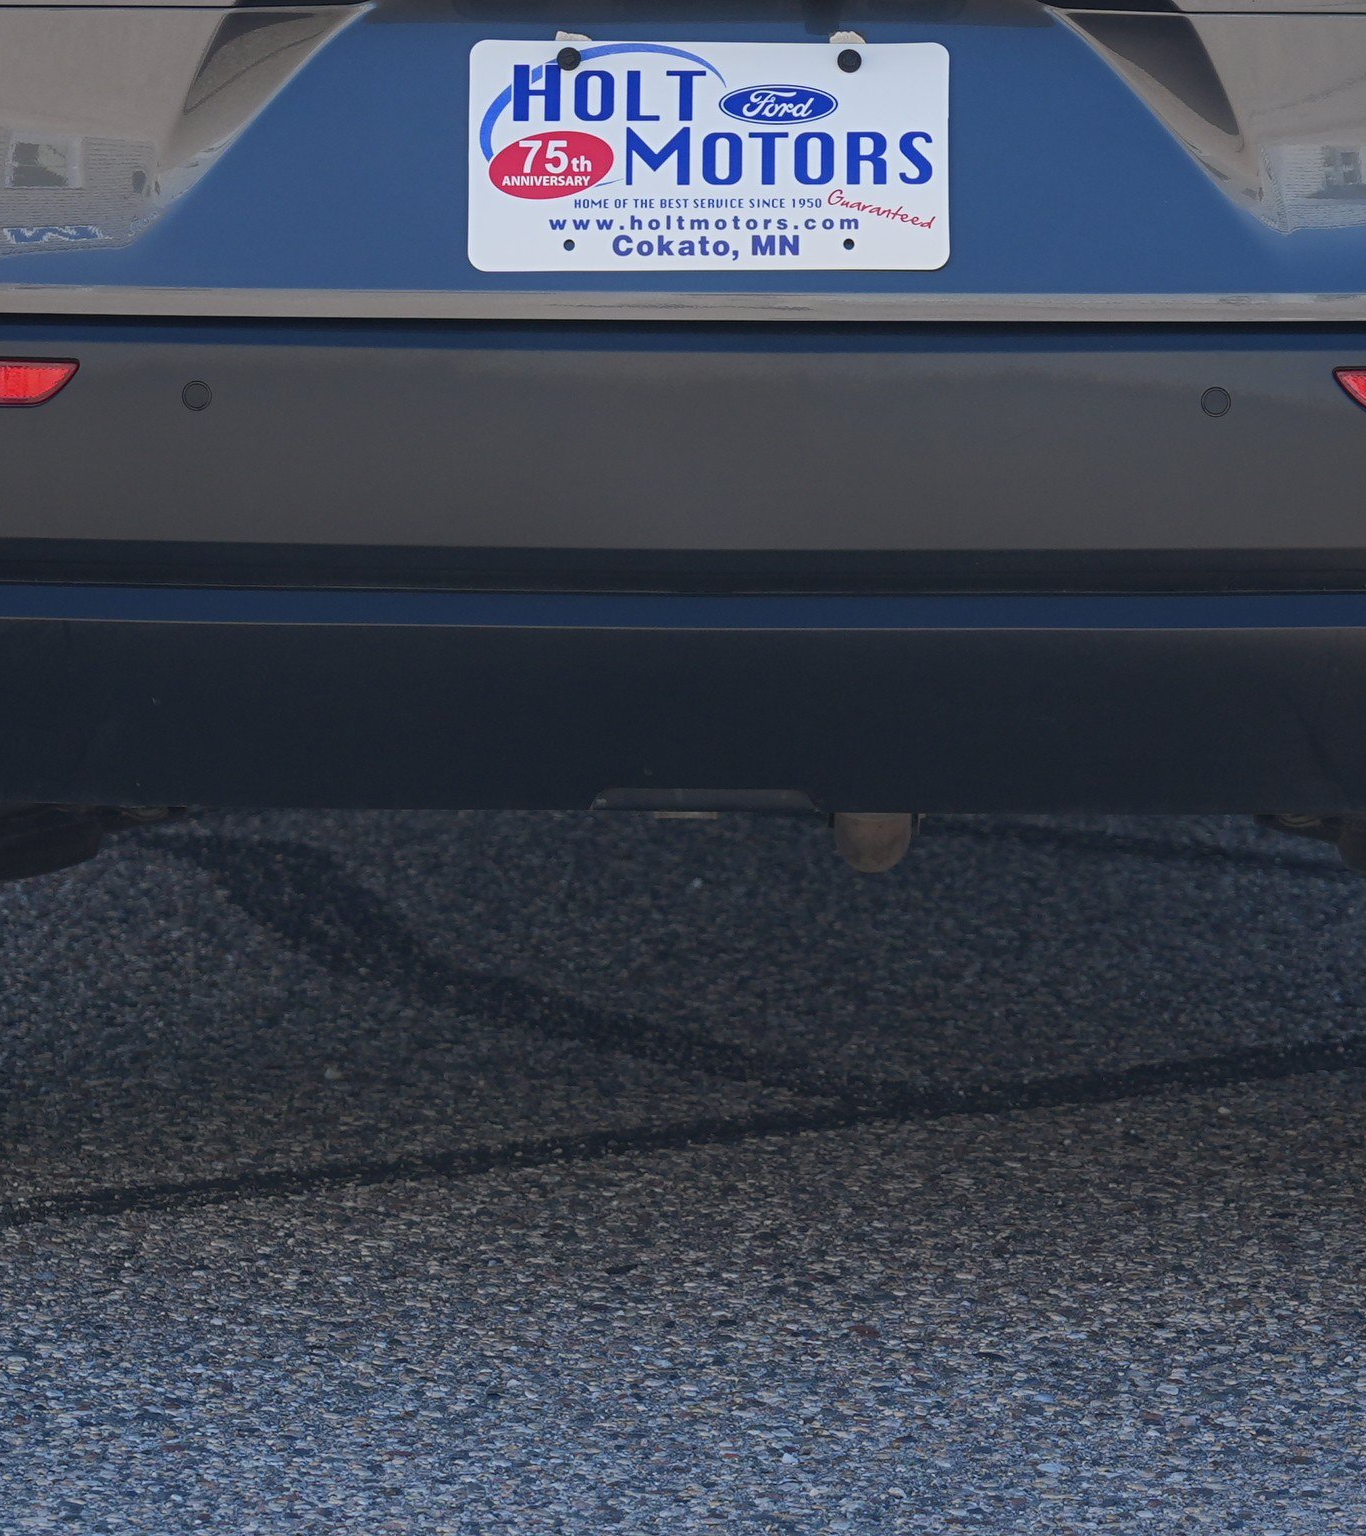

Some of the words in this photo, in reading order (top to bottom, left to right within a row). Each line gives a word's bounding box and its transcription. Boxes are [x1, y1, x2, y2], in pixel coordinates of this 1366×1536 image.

[513, 64, 707, 122] HOLT
[742, 90, 815, 118] Ford
[518, 140, 592, 174] 75th
[625, 126, 933, 186] MOTORS
[502, 175, 591, 187] ANNIVERSARY
[574, 199, 609, 209] HOME
[614, 199, 629, 209] OF
[634, 199, 655, 209] THE
[660, 199, 689, 209] BEST
[693, 198, 744, 209] SERVICE
[749, 198, 786, 209] SINCE
[792, 198, 822, 209] 1950
[827, 189, 936, 229] Guaranteed
[549, 215, 860, 231] www.holtmotors.com
[612, 234, 739, 261] Cokato,
[751, 235, 800, 256] MN
